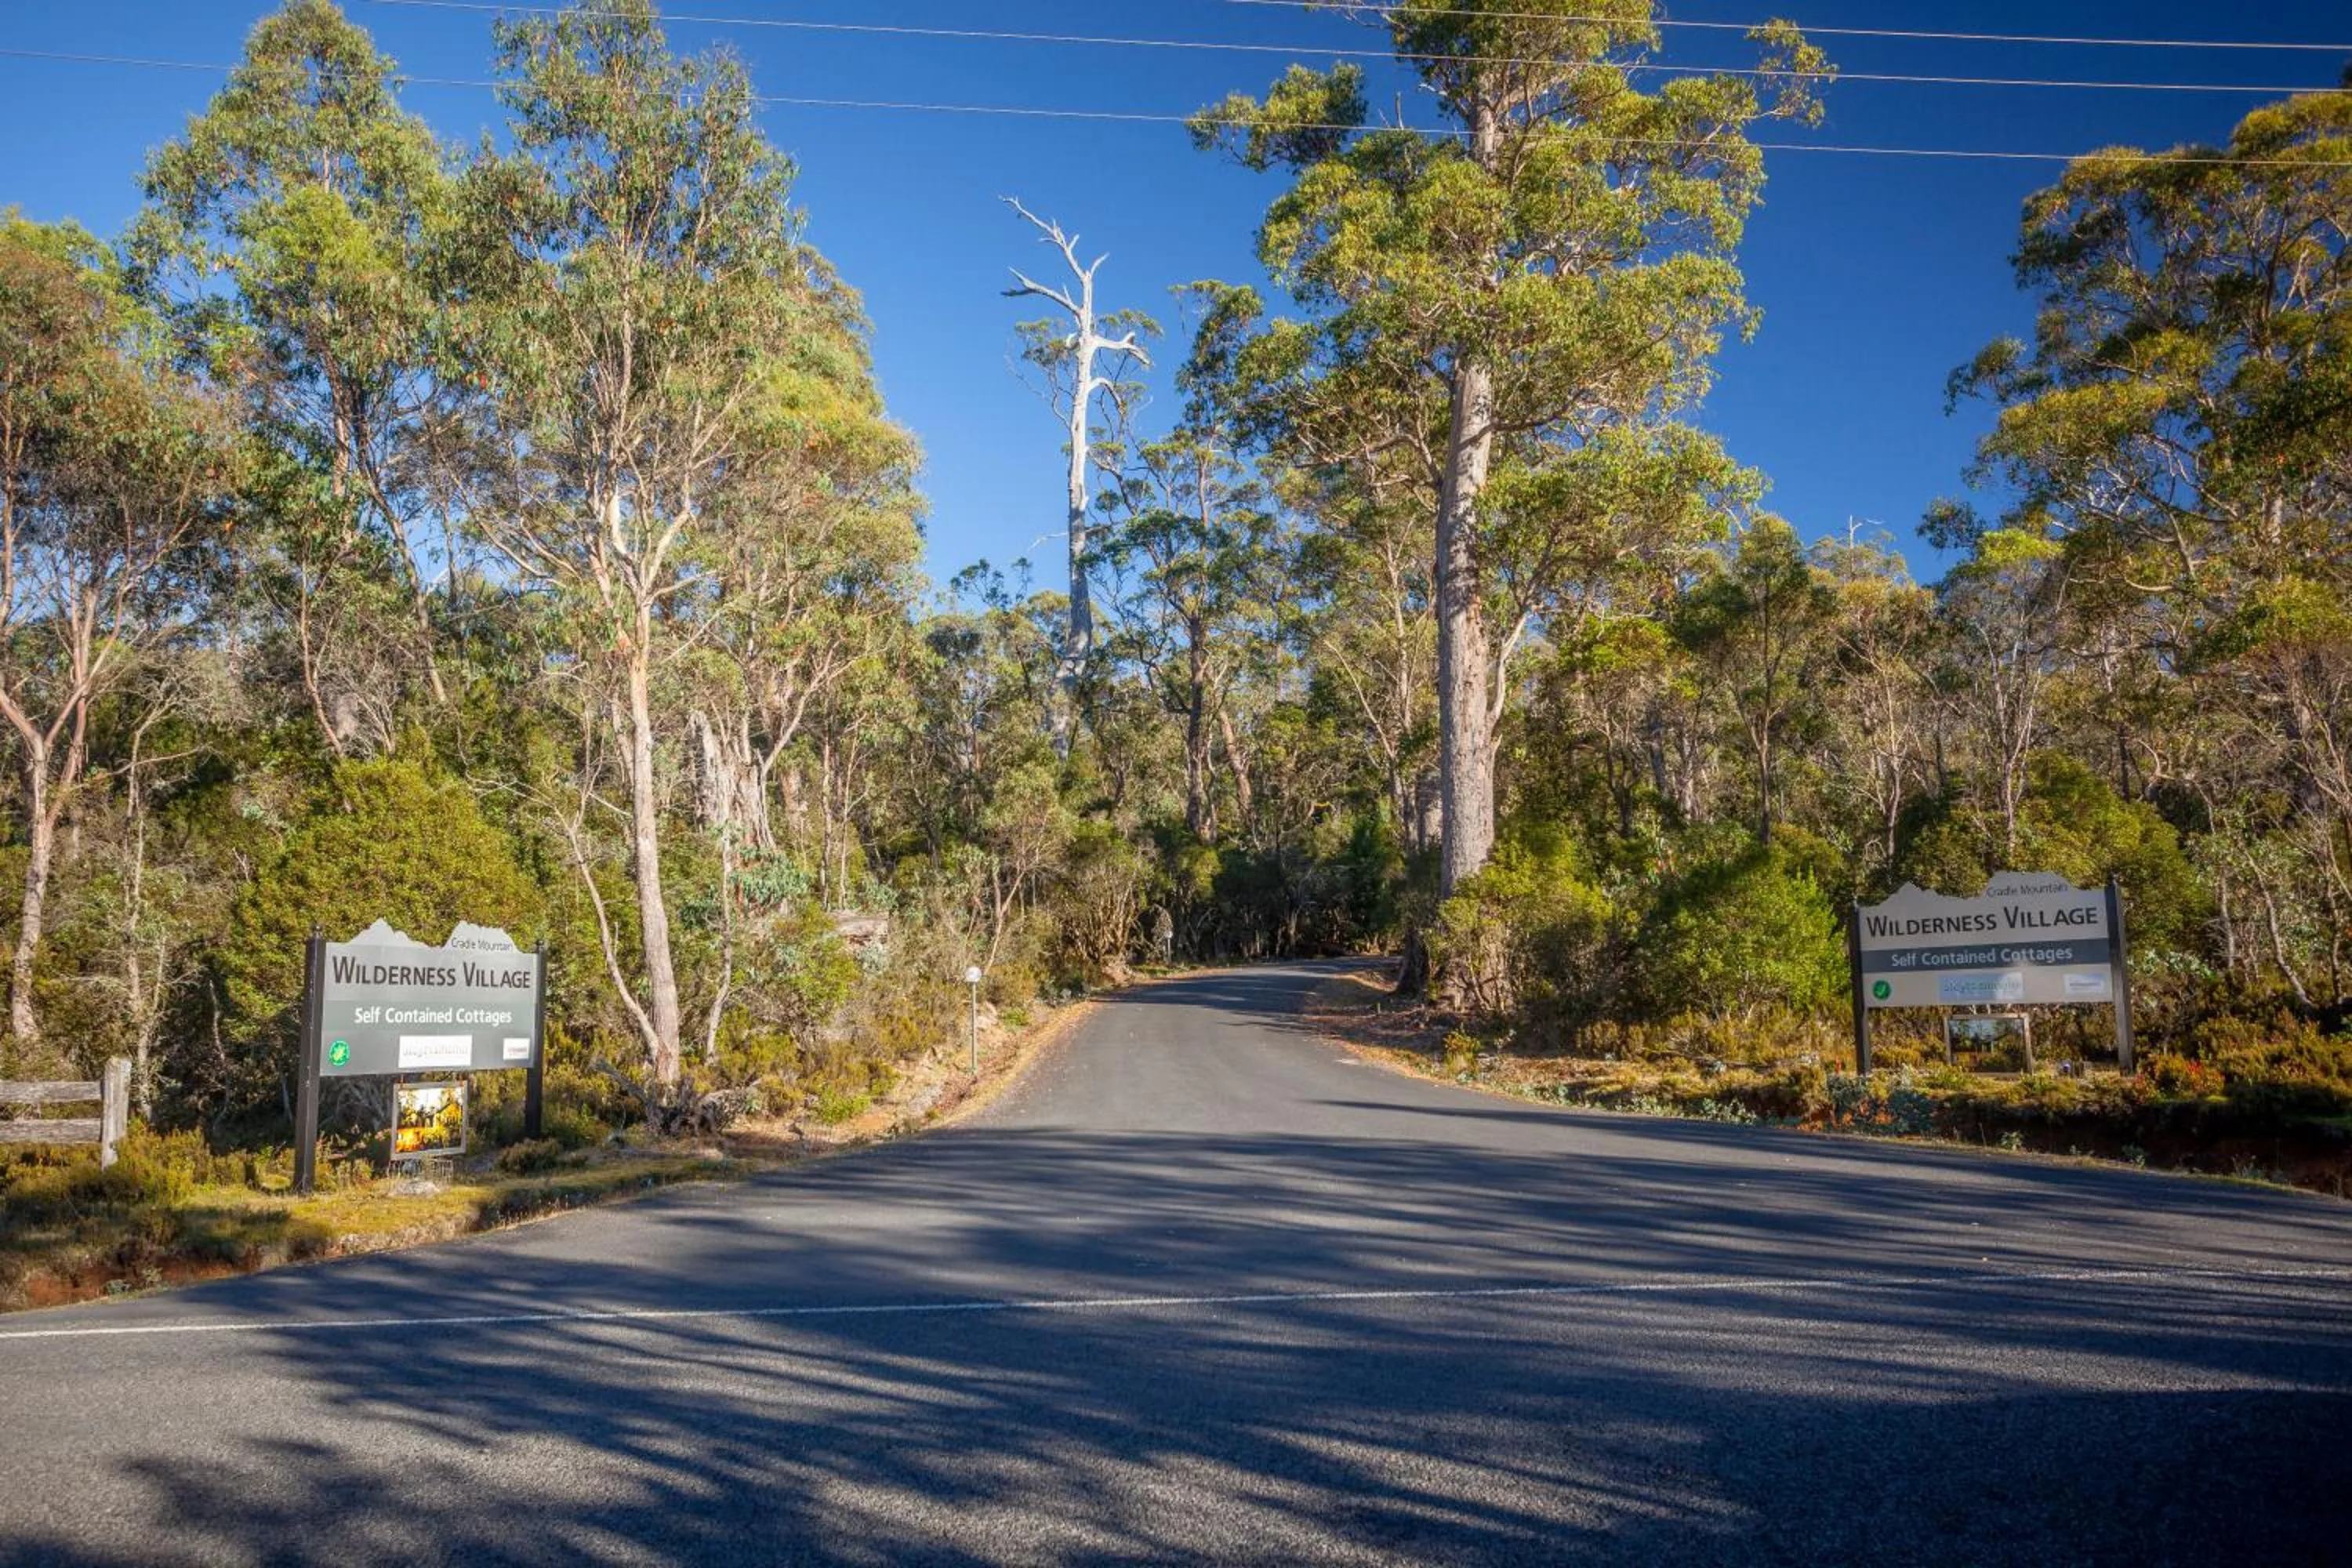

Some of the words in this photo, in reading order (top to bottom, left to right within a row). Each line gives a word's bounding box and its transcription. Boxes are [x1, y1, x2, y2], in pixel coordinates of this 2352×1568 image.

[1987, 885, 2018, 898] Cradle
[2020, 883, 2068, 895] Mountain
[1867, 913, 1997, 938] WILDERNESS
[2003, 906, 2099, 929] VILLAGE
[451, 937, 476, 949] Cradle
[477, 938, 513, 952] Mountain
[1891, 953, 1916, 967] Self
[1922, 949, 1995, 964] Contained
[2001, 947, 2073, 964] Cottages
[332, 956, 456, 987] WILDERNESS
[463, 961, 531, 989] VILLAGE
[354, 1007, 381, 1024] Self
[385, 1007, 453, 1024] Contained
[456, 1008, 512, 1027] Cottages
